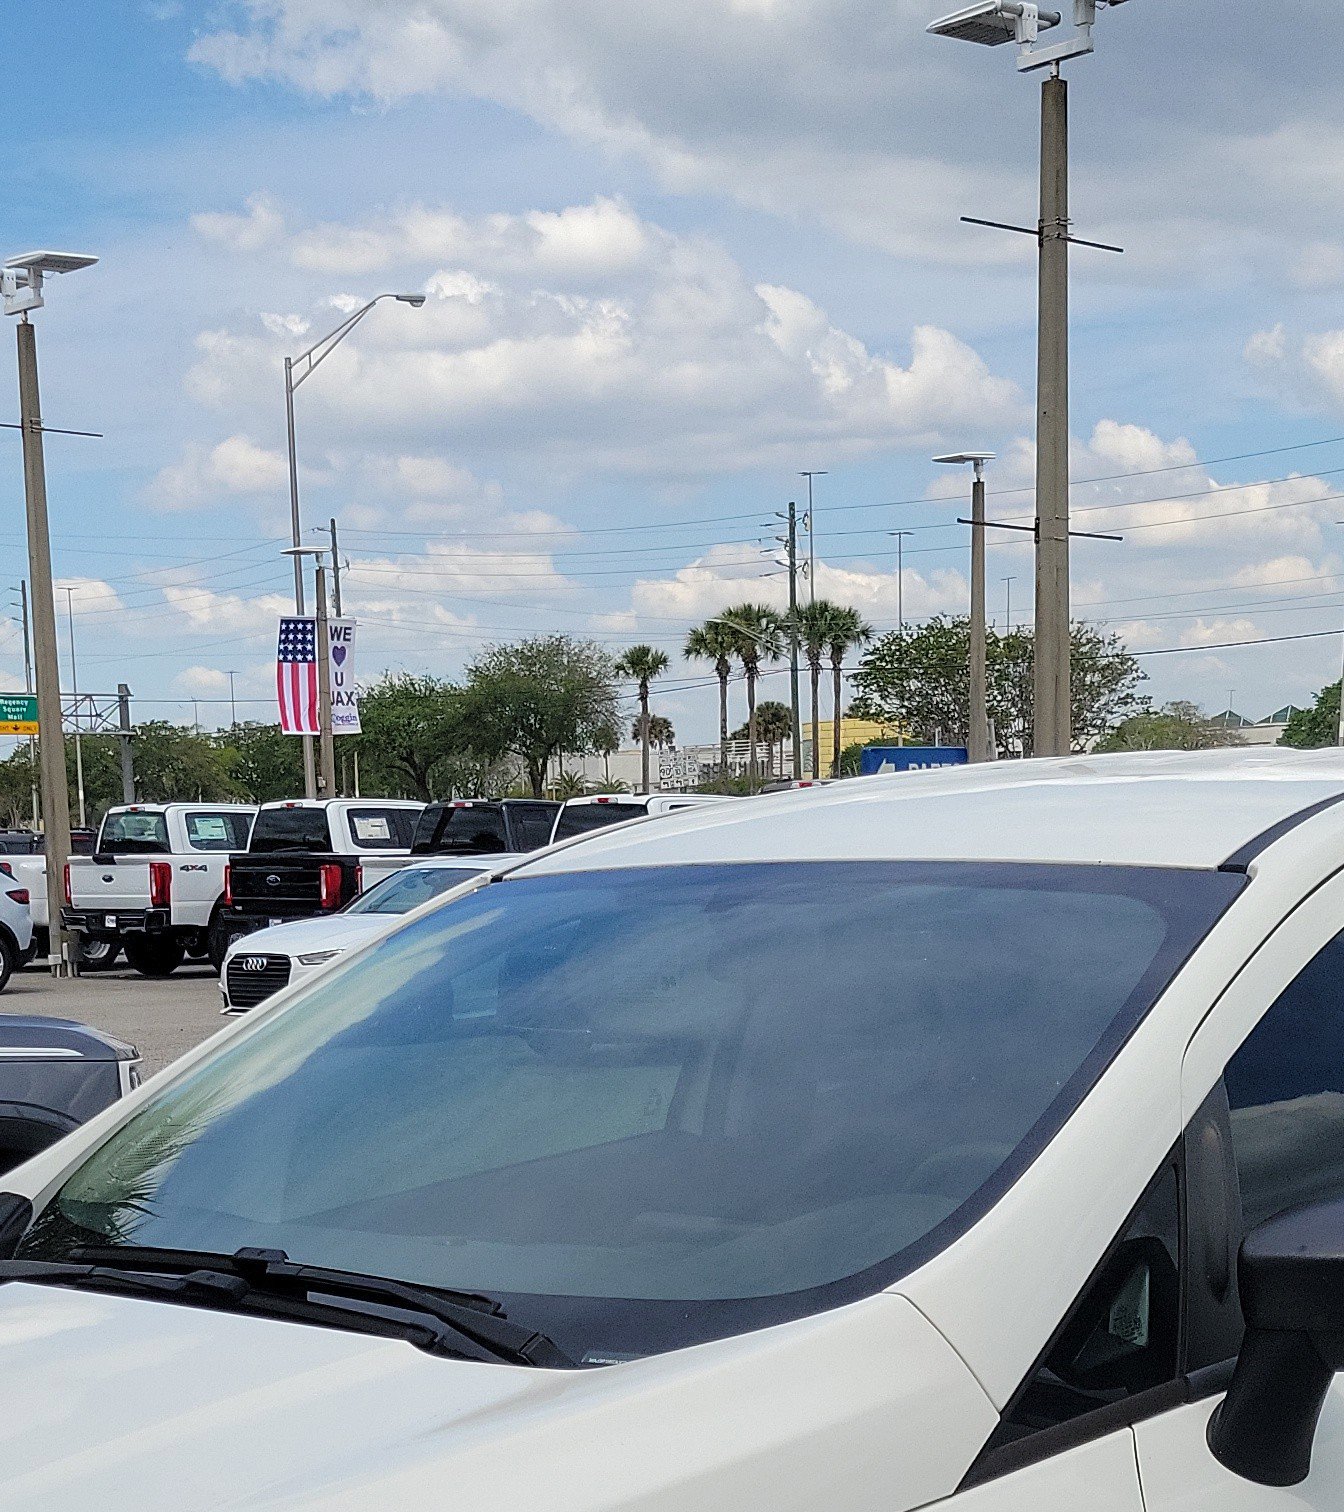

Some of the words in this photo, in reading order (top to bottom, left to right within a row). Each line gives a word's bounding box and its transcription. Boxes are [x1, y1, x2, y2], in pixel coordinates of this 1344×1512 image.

[329, 626, 353, 642] WE
[335, 672, 344, 687] U
[331, 691, 356, 707] JAX
